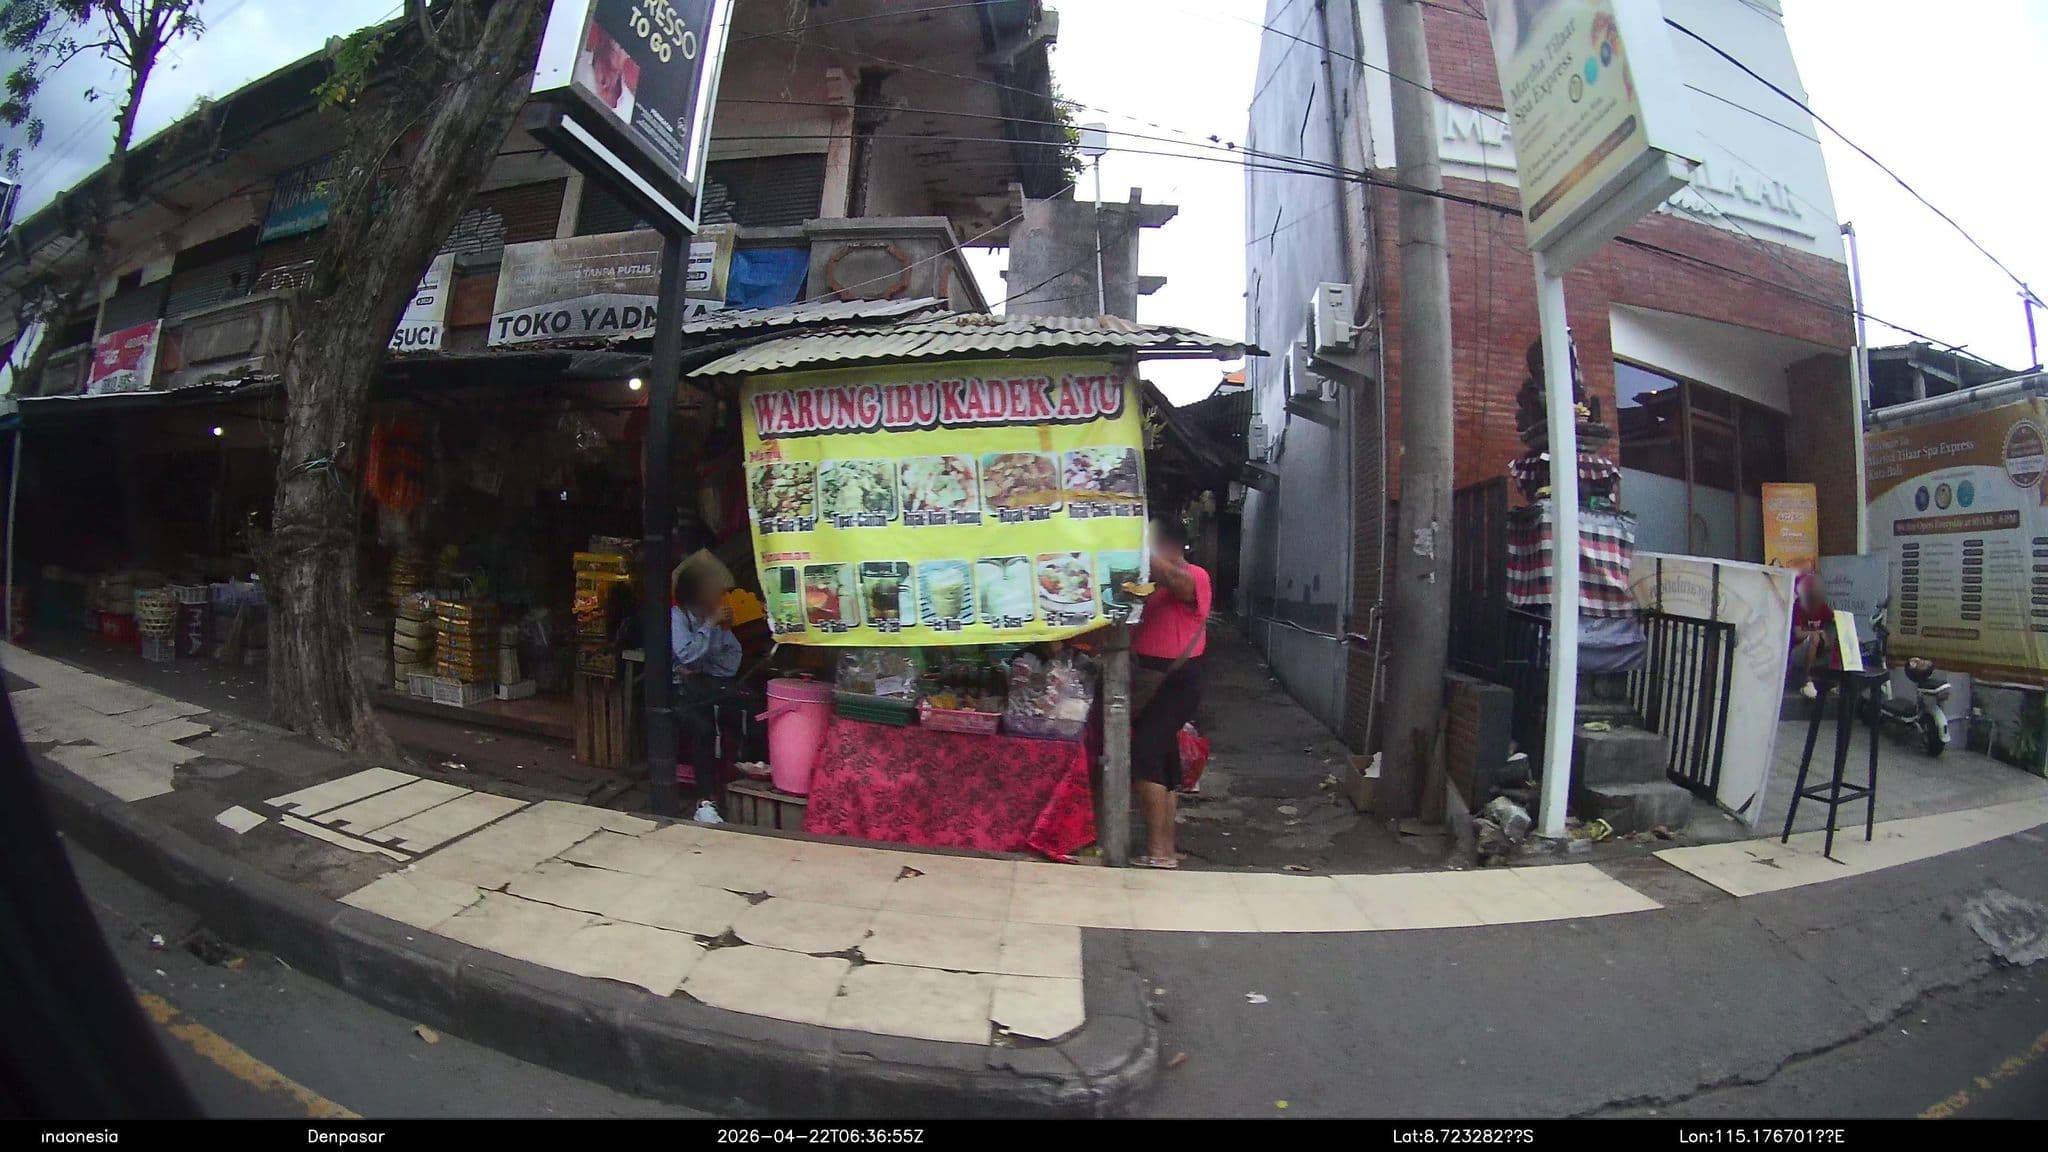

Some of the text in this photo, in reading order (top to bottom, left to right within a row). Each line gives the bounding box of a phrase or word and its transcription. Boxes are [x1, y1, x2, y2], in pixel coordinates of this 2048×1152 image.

[629, 6, 671, 63] TO GO
[1533, 51, 1574, 102] Express
[616, 264, 651, 276] PUTUS
[498, 309, 571, 340] TOKO
[754, 374, 1123, 434] WARUNG IBU KADEK AYU
[1939, 439, 1976, 457] Express
